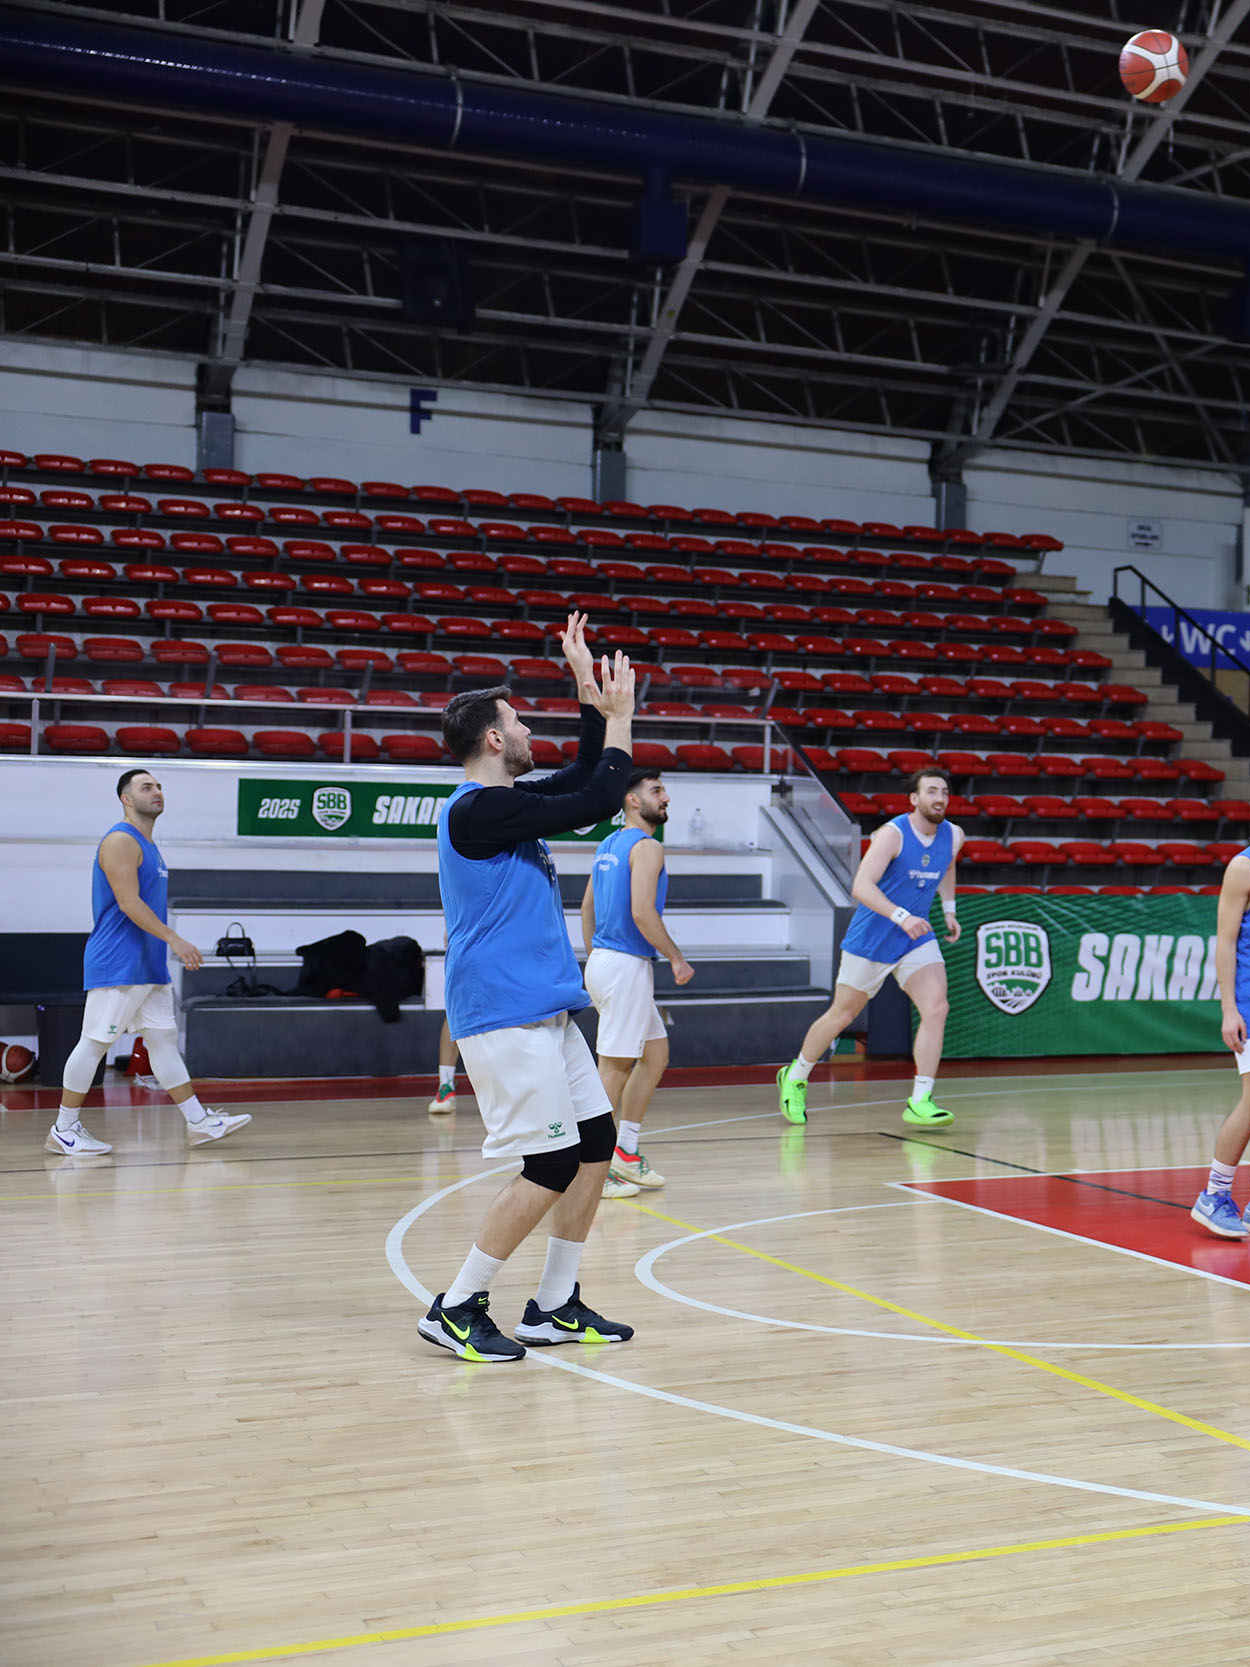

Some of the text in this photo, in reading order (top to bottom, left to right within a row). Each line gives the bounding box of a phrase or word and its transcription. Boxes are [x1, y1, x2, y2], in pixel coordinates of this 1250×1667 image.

[410, 389, 438, 435] F
[1179, 621, 1236, 656] WC
[258, 798, 301, 819] 2025
[316, 792, 347, 810] SBB
[984, 930, 1043, 969] SBB
